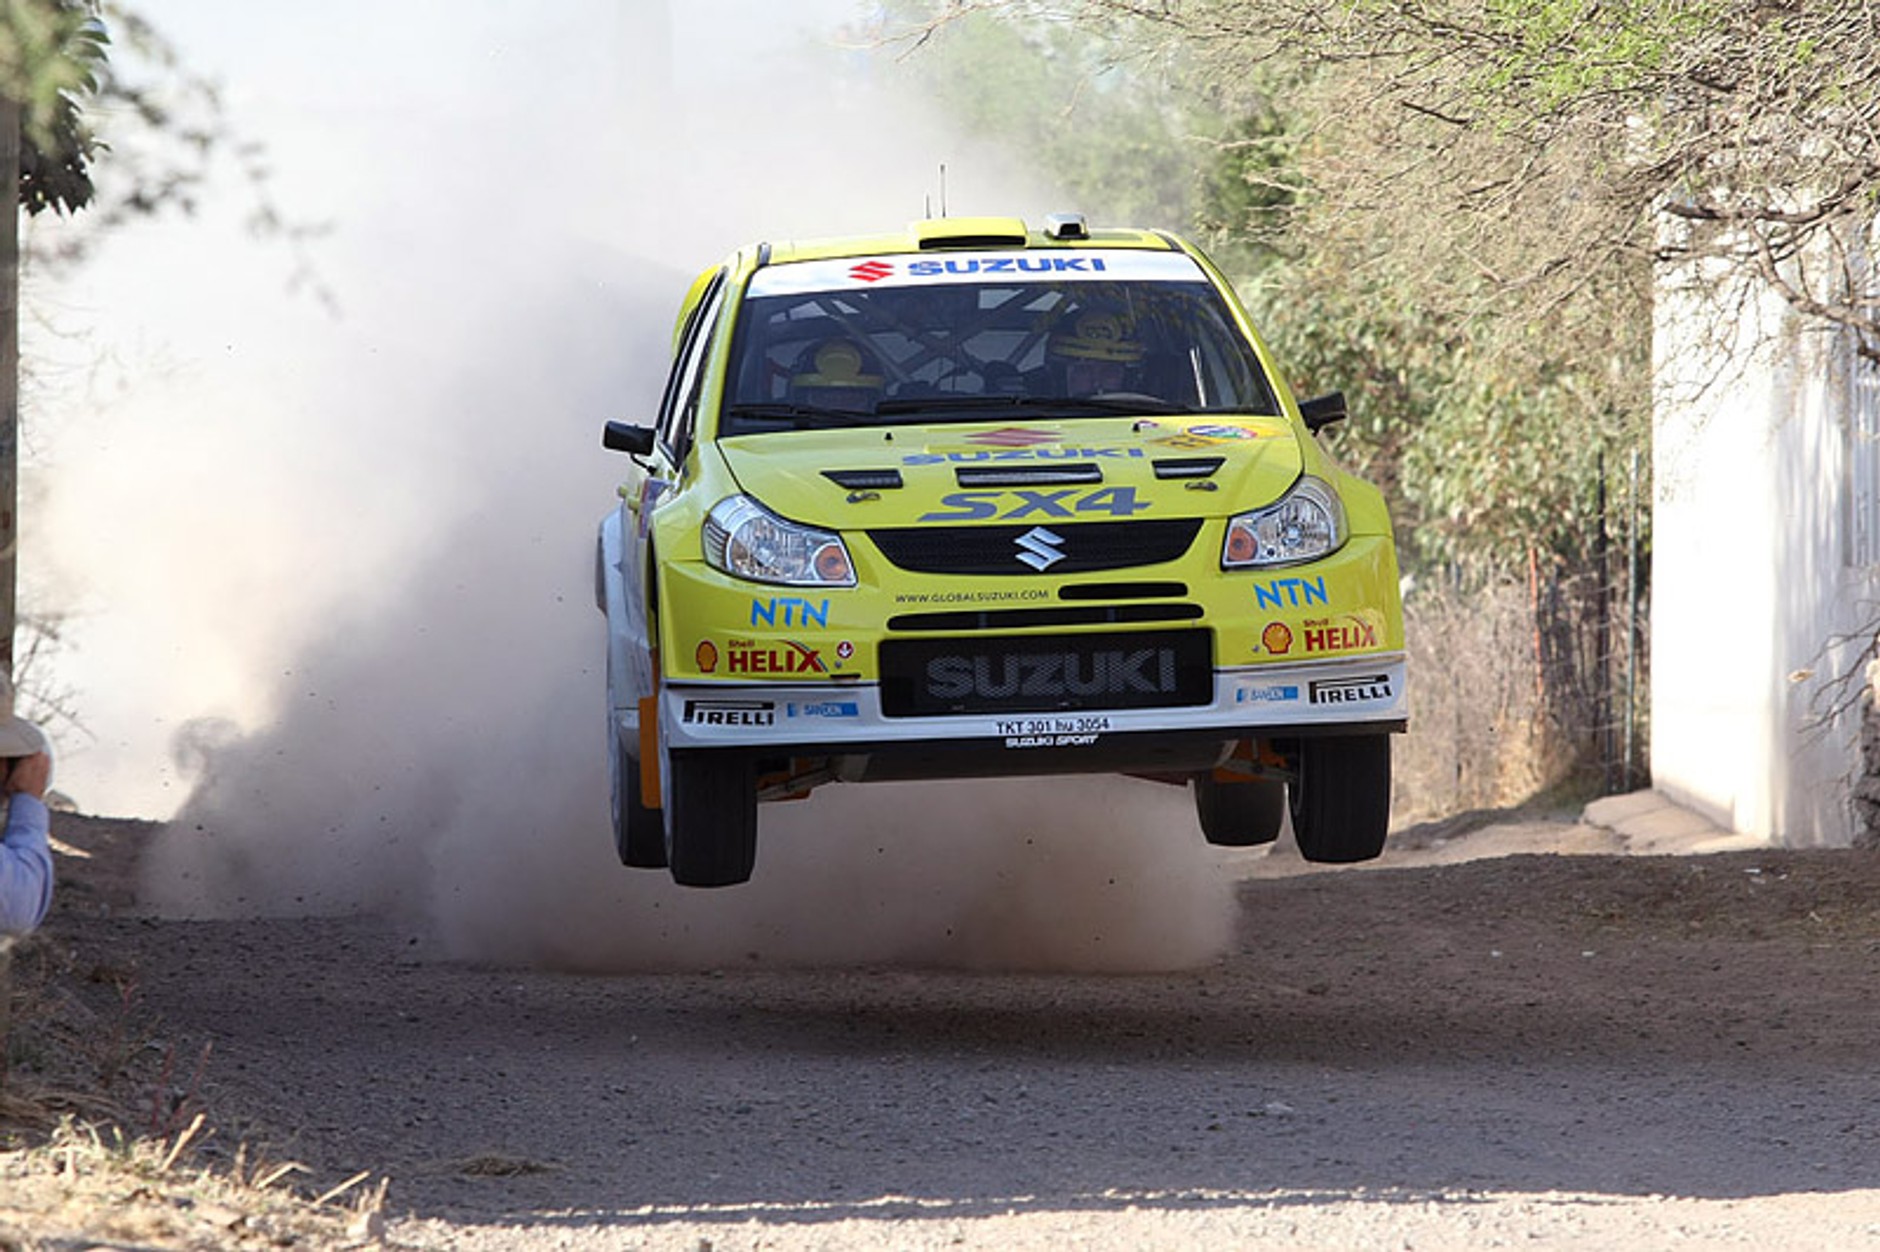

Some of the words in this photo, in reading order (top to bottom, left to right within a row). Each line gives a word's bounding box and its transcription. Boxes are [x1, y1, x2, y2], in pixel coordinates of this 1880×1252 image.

[907, 257, 1106, 276] SUZUKI
[902, 448, 1144, 465] SUZUKI
[916, 486, 1152, 522] SX4
[895, 589, 1049, 603] WWW.GLOBALSUZUKI.COM
[1253, 576, 1329, 609] NTN
[751, 598, 830, 627] NTN
[1303, 626, 1377, 652] HELIX
[728, 645, 827, 673] HELIX
[926, 650, 1177, 699] SUZUKI
[1309, 674, 1392, 703] PIRELLI
[683, 700, 774, 725] PIRELLI
[997, 721, 1022, 734] TKT
[1026, 720, 1051, 733] 301
[1078, 717, 1109, 731] 3054
[1005, 737, 1053, 747] SUZUKI
[1055, 735, 1098, 746] SPORT
